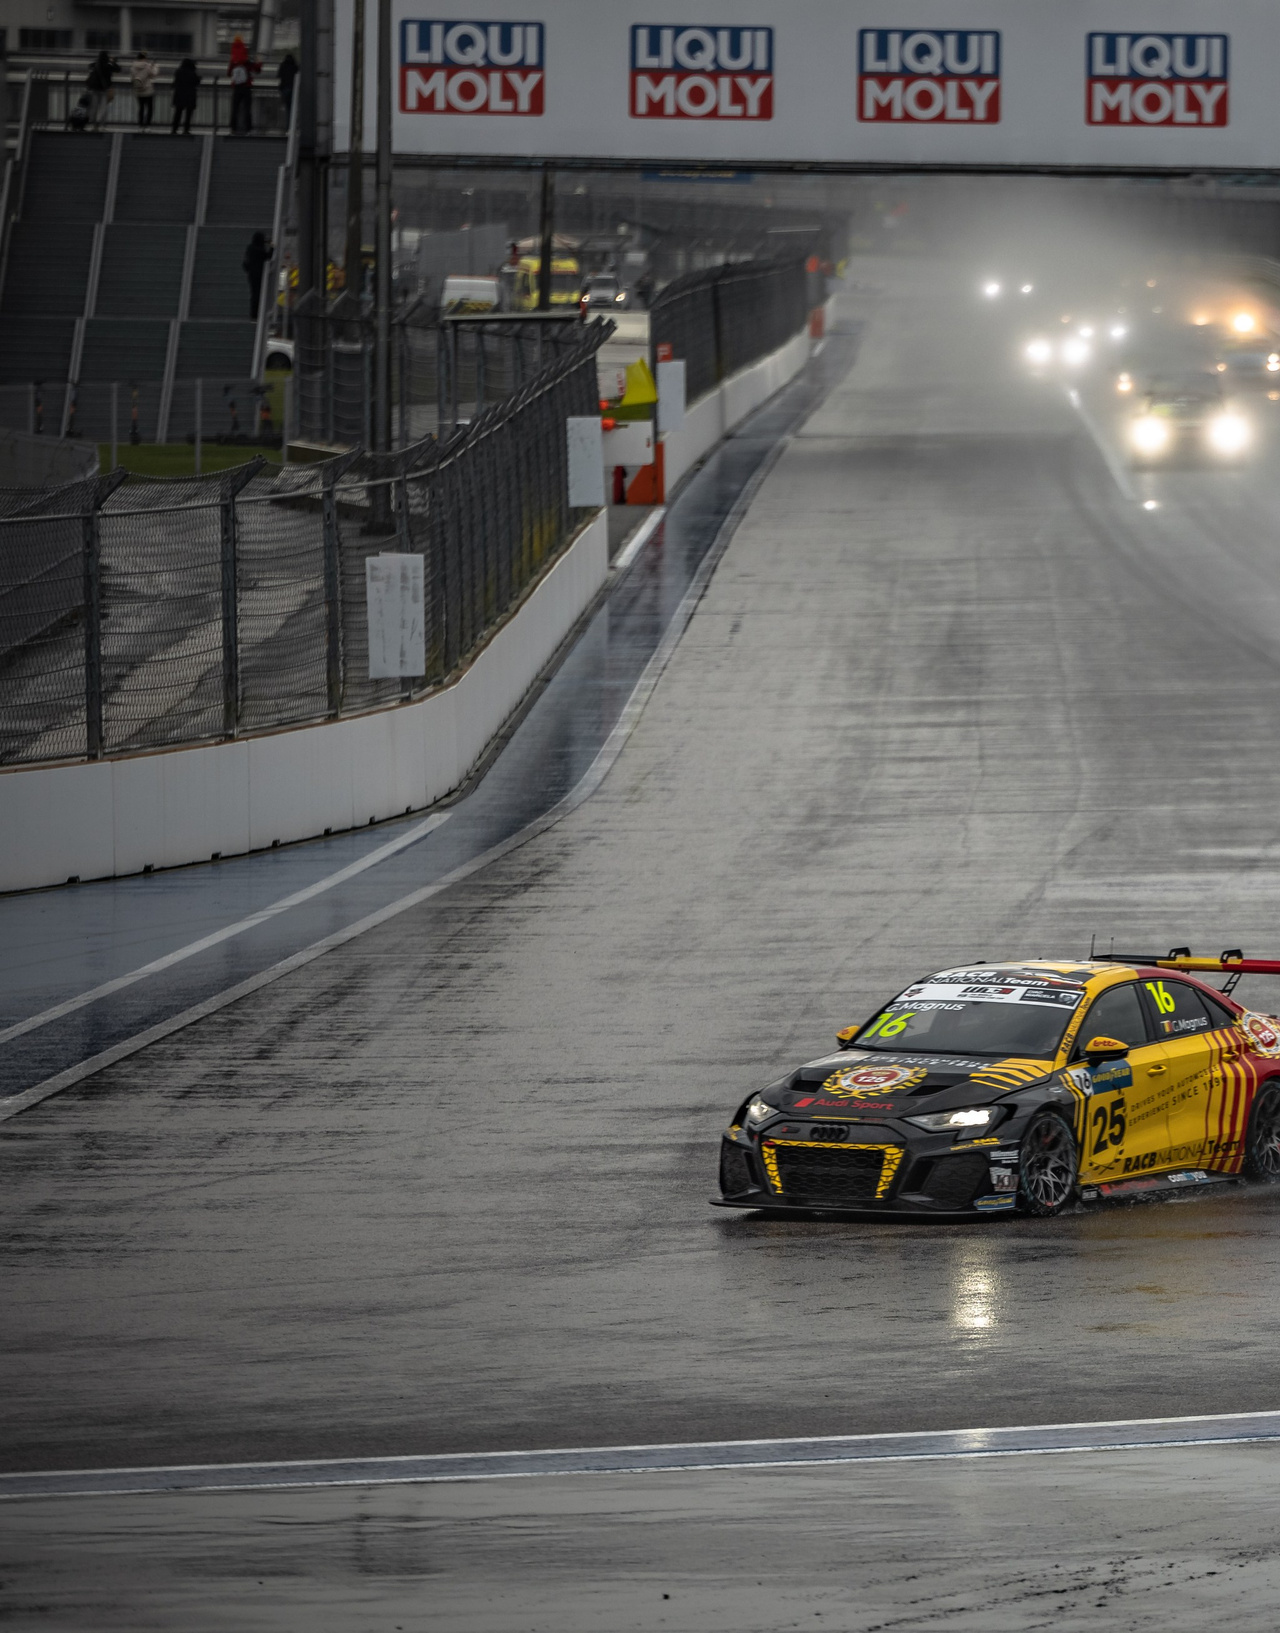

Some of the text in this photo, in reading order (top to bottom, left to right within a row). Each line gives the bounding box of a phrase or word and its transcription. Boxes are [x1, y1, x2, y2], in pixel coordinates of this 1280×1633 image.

[405, 23, 538, 67] LIQUI
[635, 28, 767, 72] LIQUI
[863, 31, 994, 75] LIQUI
[1091, 34, 1222, 78] LIQUI
[405, 69, 541, 112] MOLY
[635, 74, 770, 117] MOLY
[863, 77, 997, 121] MOLY
[1091, 80, 1225, 124] MOLY
[884, 1001, 967, 1013] G.Magnus
[1145, 981, 1176, 1014] 16
[863, 1013, 916, 1038] 16
[1171, 1016, 1208, 1031] G.Magnus
[1076, 1074, 1092, 1091] 16
[1130, 1097, 1155, 1113] DRIVES
[1157, 1086, 1175, 1098] YOUR
[815, 1099, 894, 1110] Audi Sport
[1128, 1101, 1169, 1126] EXPERIENCE
[1172, 1087, 1199, 1106] SINCE
[1092, 1098, 1126, 1156] 25
